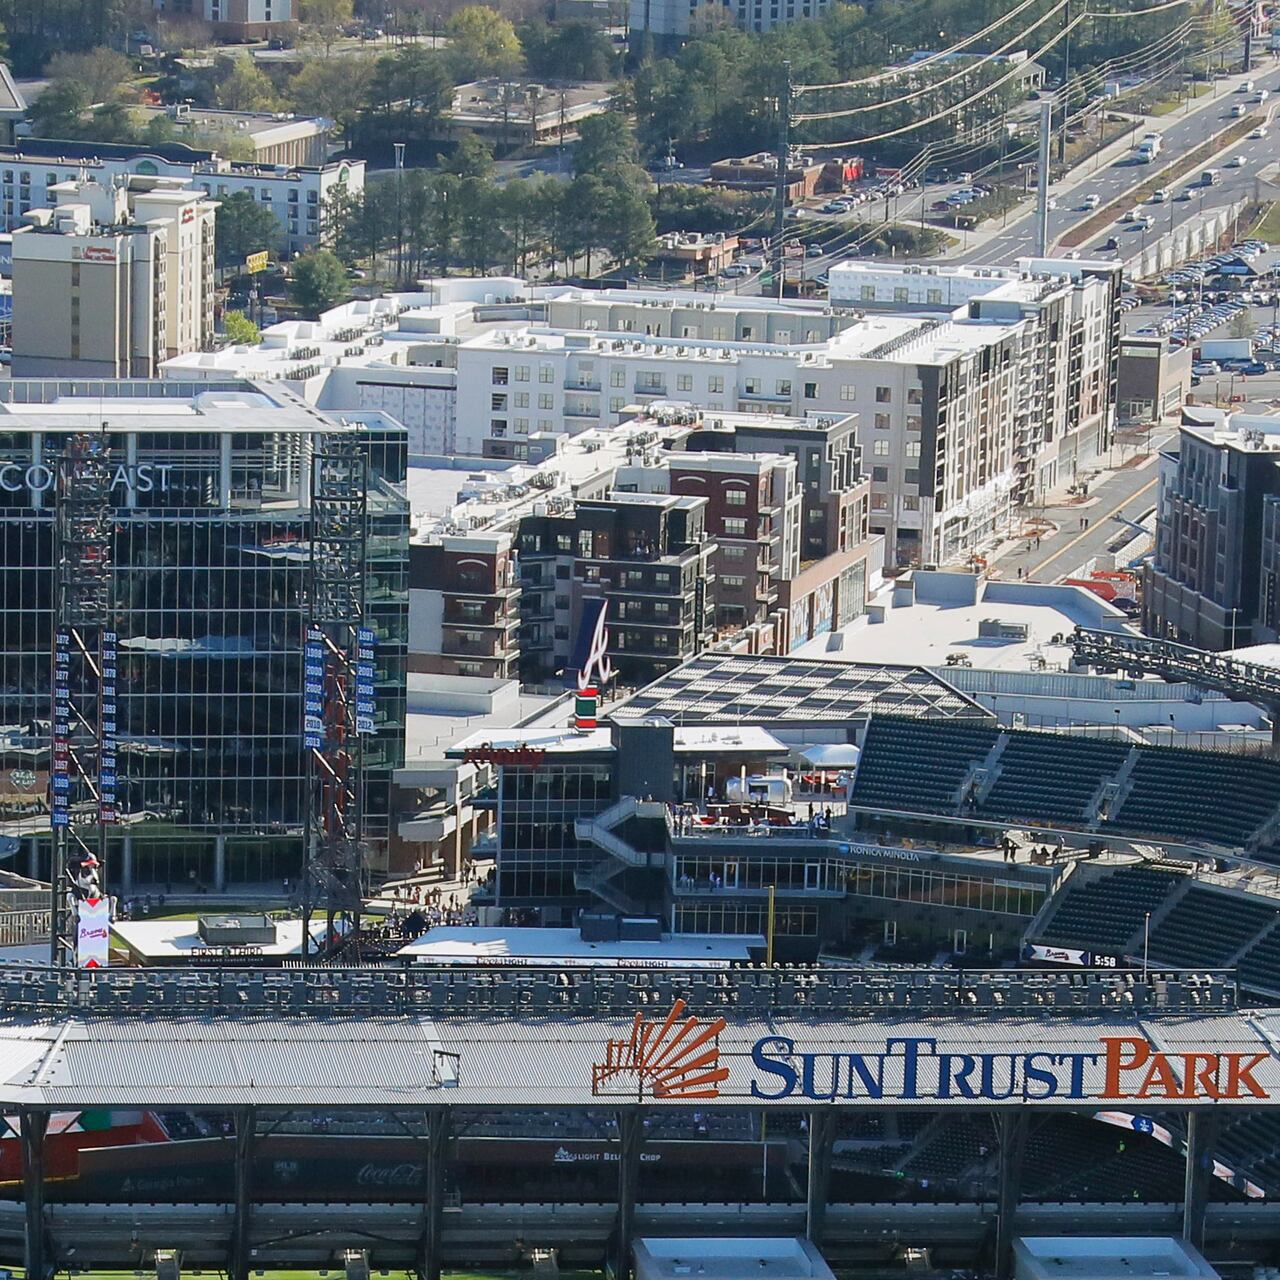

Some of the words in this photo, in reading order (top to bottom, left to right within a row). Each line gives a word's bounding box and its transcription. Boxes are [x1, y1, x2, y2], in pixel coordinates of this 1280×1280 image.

[850, 845, 882, 857] KONICA
[883, 849, 920, 863] MINOLTA
[79, 928, 107, 939] Braves
[1095, 955, 1116, 967] 5:58
